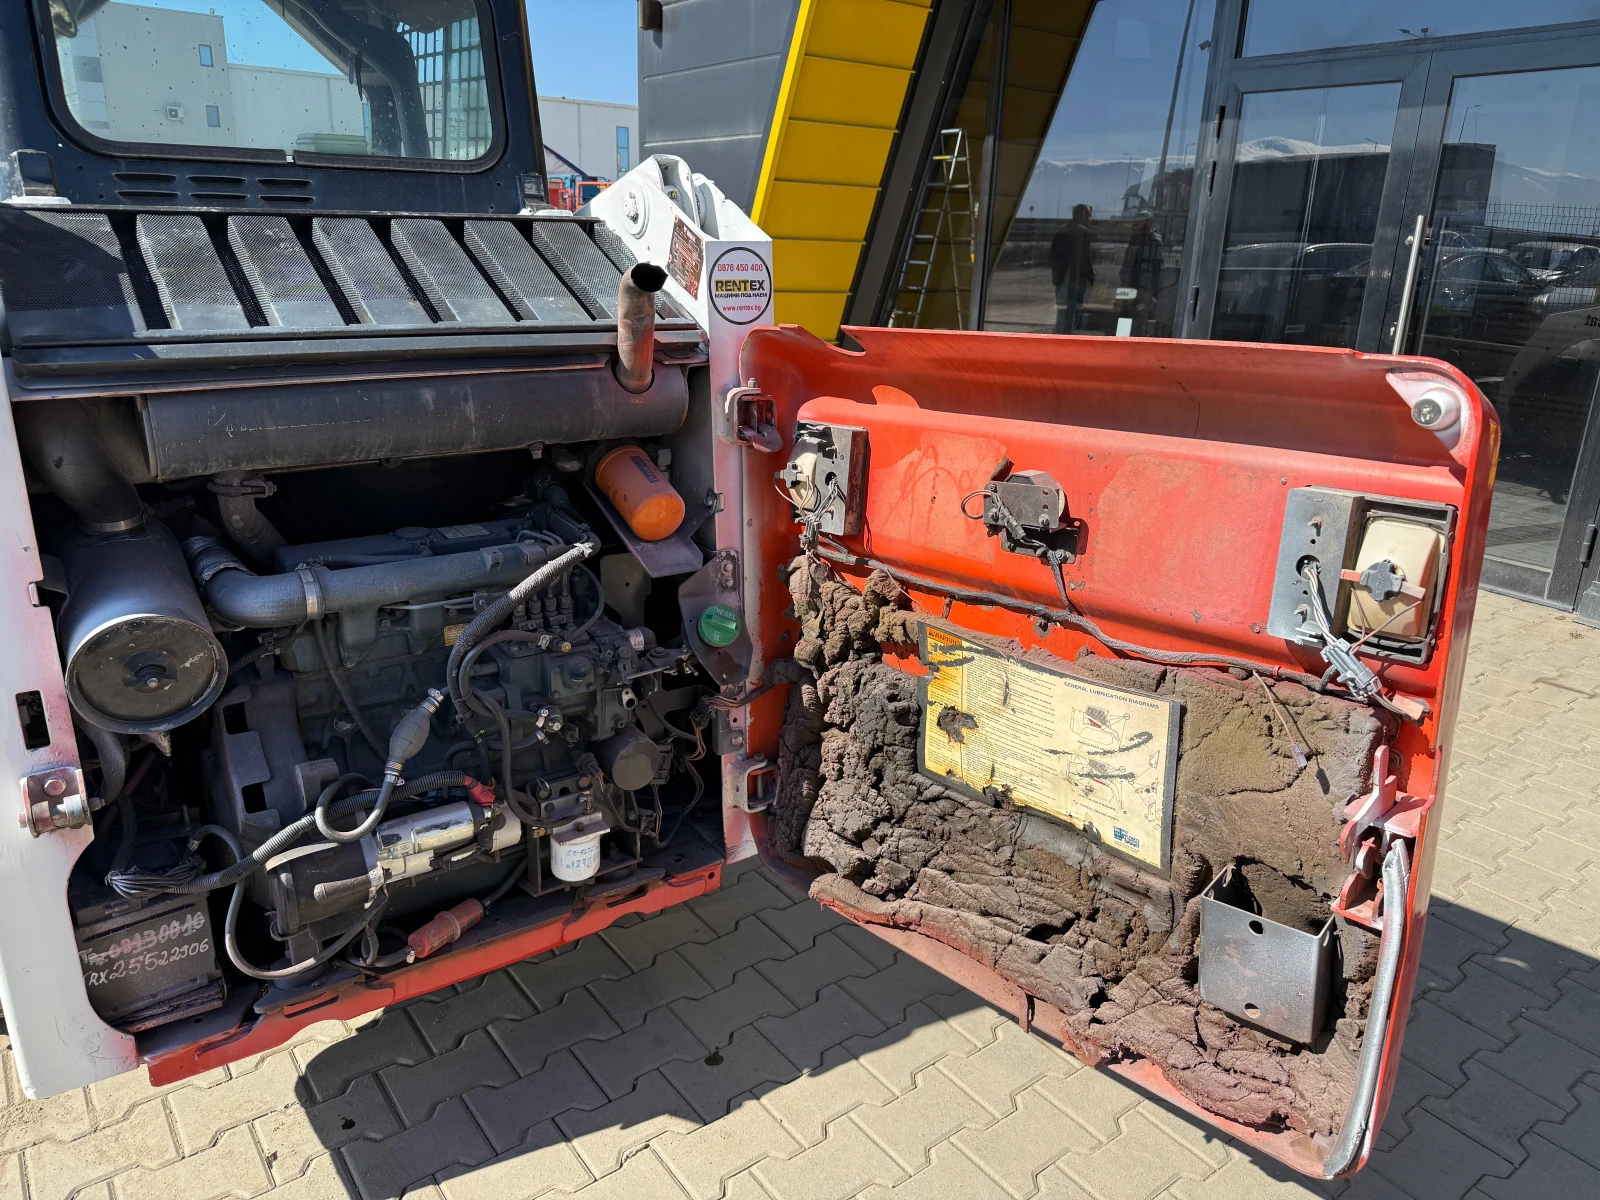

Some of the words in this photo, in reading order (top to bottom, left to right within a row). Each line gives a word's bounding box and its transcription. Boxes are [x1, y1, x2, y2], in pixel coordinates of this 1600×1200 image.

[717, 263, 735, 272] 0878
[736, 263, 749, 272] 450
[750, 263, 764, 272] 400
[715, 279, 766, 292] RENTEX
[722, 304, 762, 312] www.rentex.bg
[713, 606, 737, 621] DIESEL
[1063, 681, 1089, 693] GENERAL
[1089, 688, 1128, 702] LUBRICATION
[1128, 697, 1160, 710] DIAGRAMS
